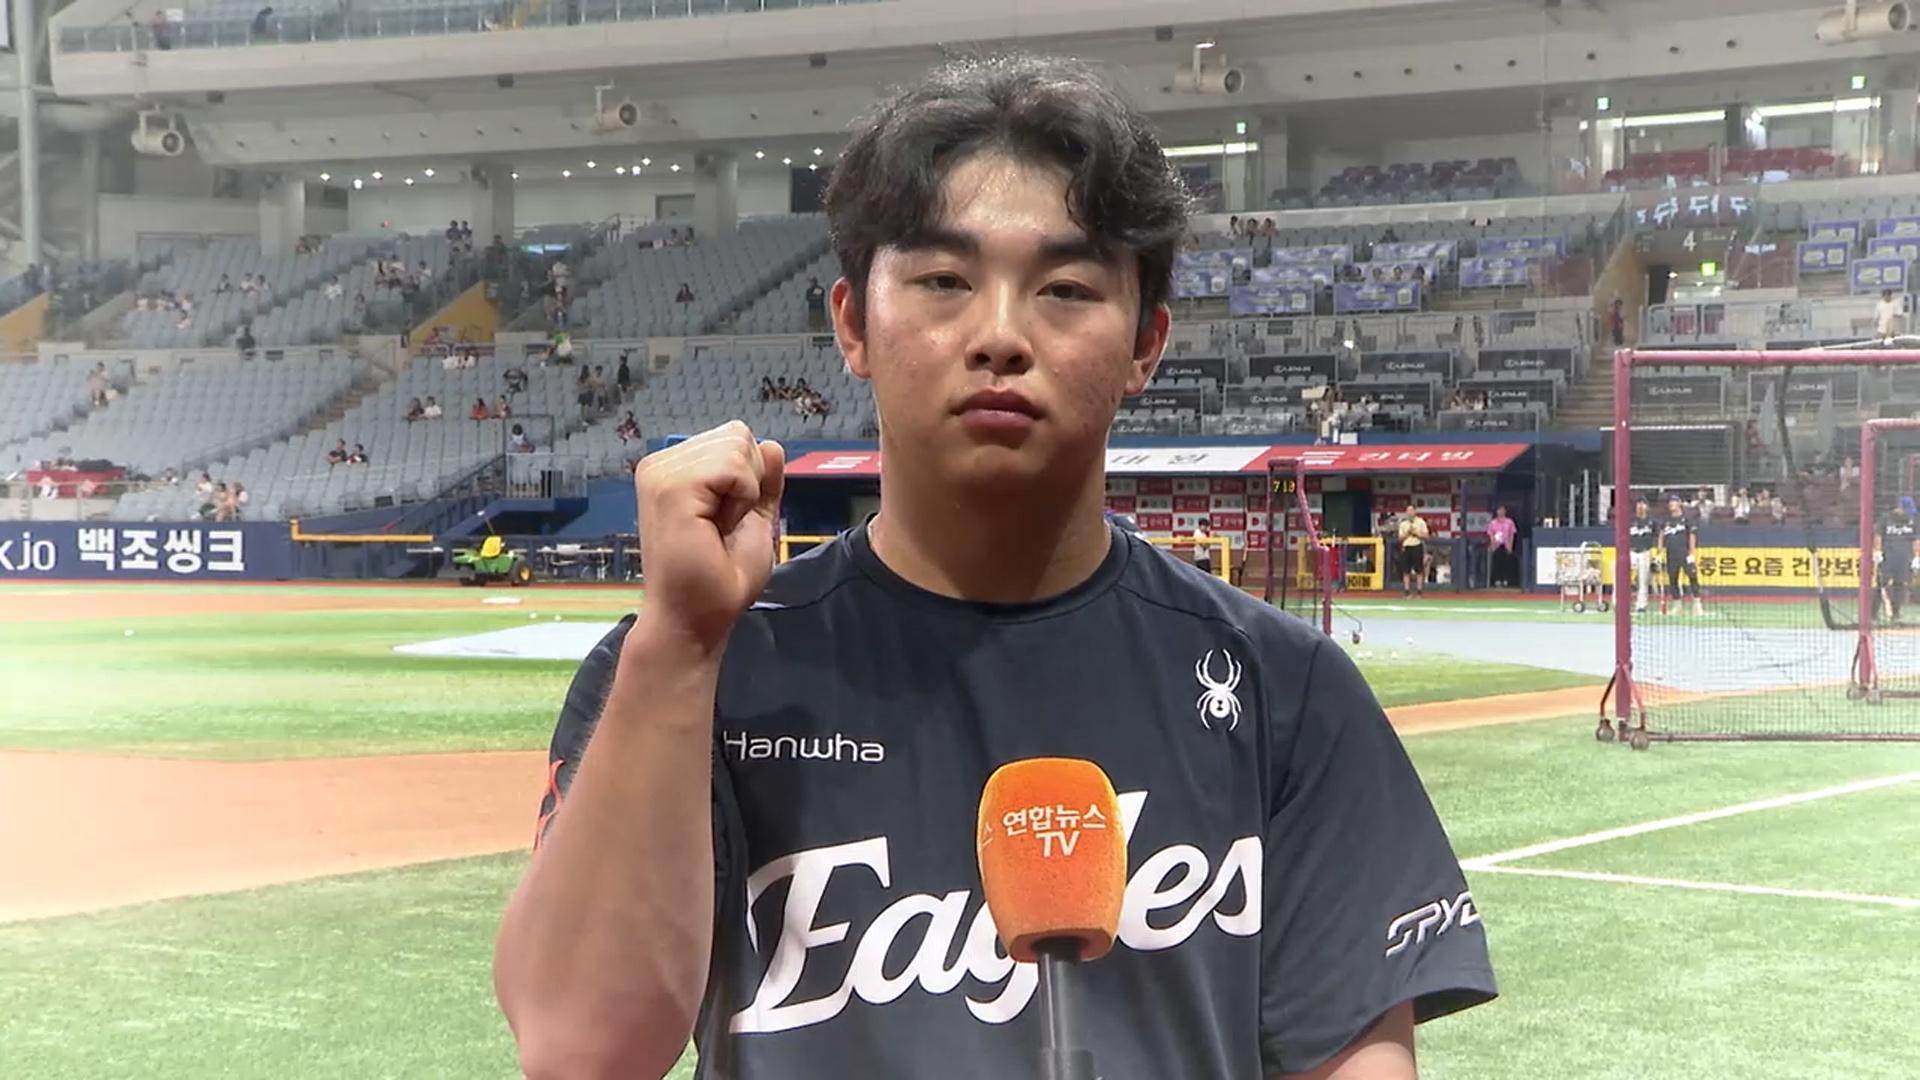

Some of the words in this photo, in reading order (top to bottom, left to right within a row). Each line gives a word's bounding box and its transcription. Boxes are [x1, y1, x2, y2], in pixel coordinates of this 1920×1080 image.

[1682, 230, 1697, 252] 4
[77, 528, 245, 574] 백조씽크
[1699, 556, 1738, 577] 좋은
[1743, 556, 1785, 578] 요즘
[1792, 556, 1863, 578] 건강보
[722, 730, 886, 763] Hanwha
[1002, 804, 1107, 837] 연합뉴스
[1036, 830, 1081, 858] TV
